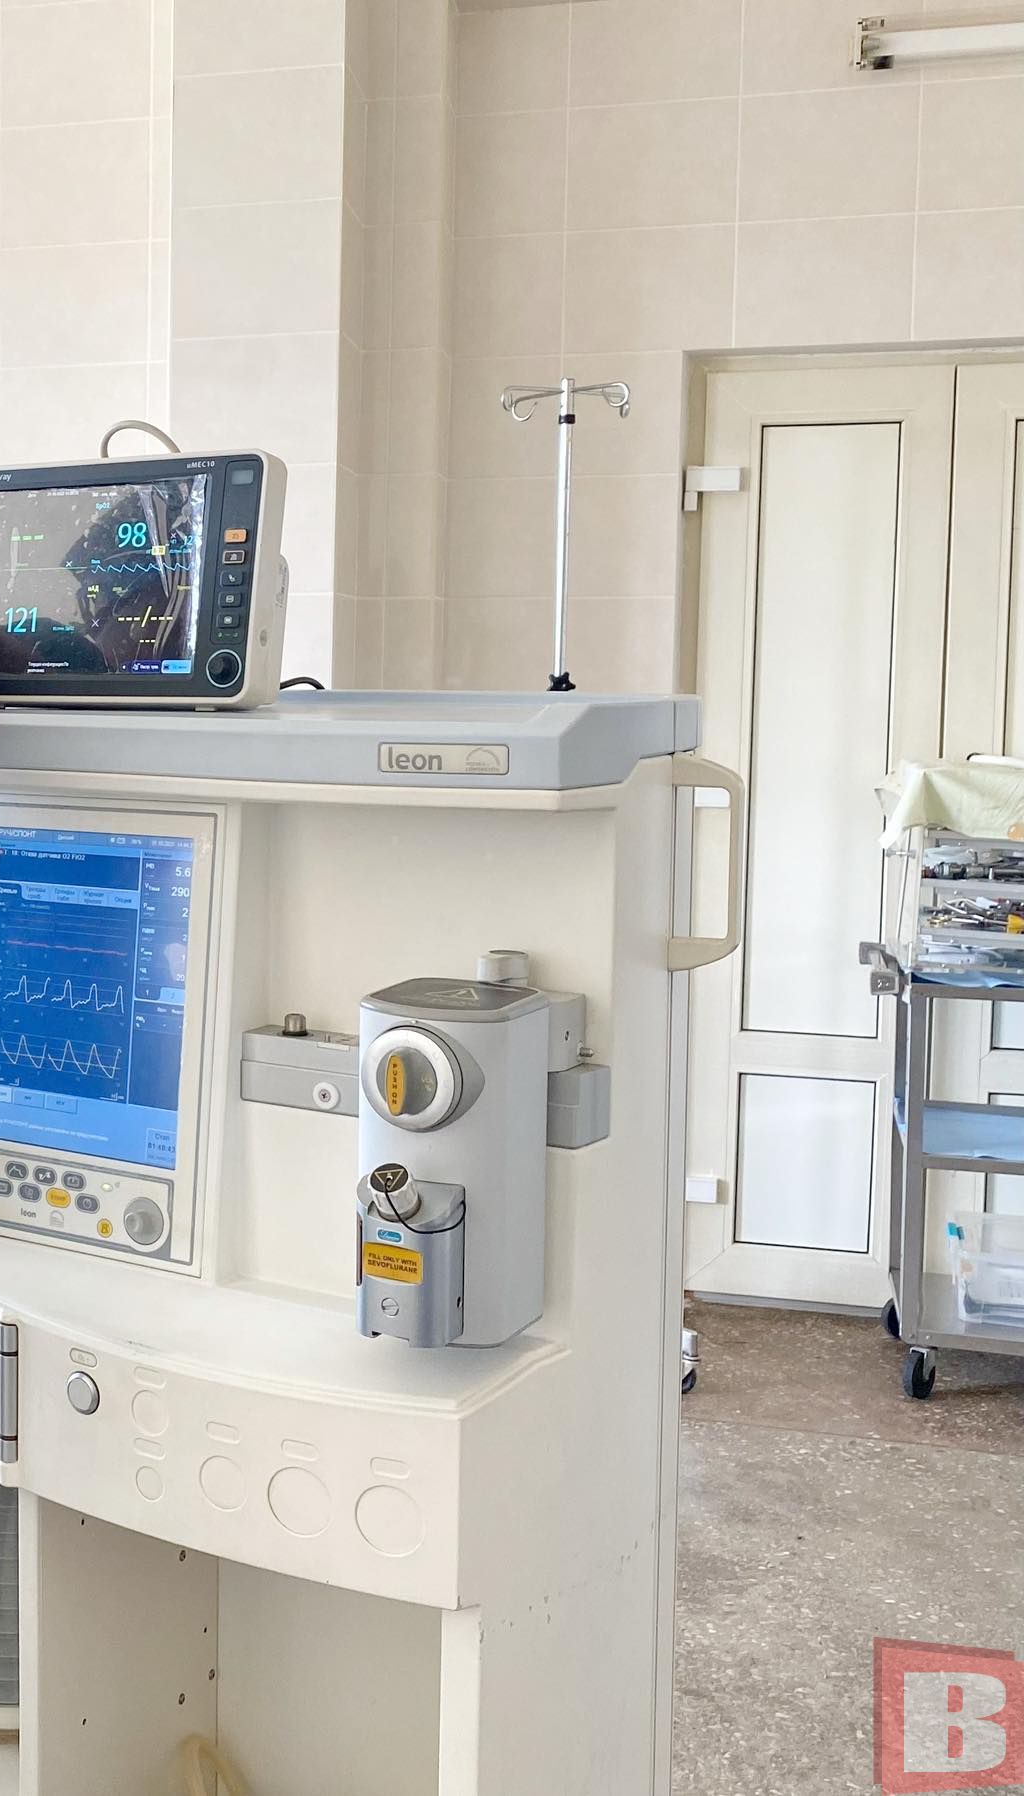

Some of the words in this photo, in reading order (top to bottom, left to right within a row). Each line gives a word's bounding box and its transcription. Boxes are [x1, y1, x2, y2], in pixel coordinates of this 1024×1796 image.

[117, 522, 147, 548] 98
[4, 606, 38, 633] 121
[387, 746, 443, 771] leon
[175, 866, 192, 878] 5.6
[170, 886, 191, 898] 290
[20, 1207, 37, 1219] leon
[368, 1252, 381, 1260] FILL
[383, 1255, 401, 1263] ONLY
[401, 1258, 417, 1267] WITH
[368, 1259, 418, 1274] SEVOFLURANE
